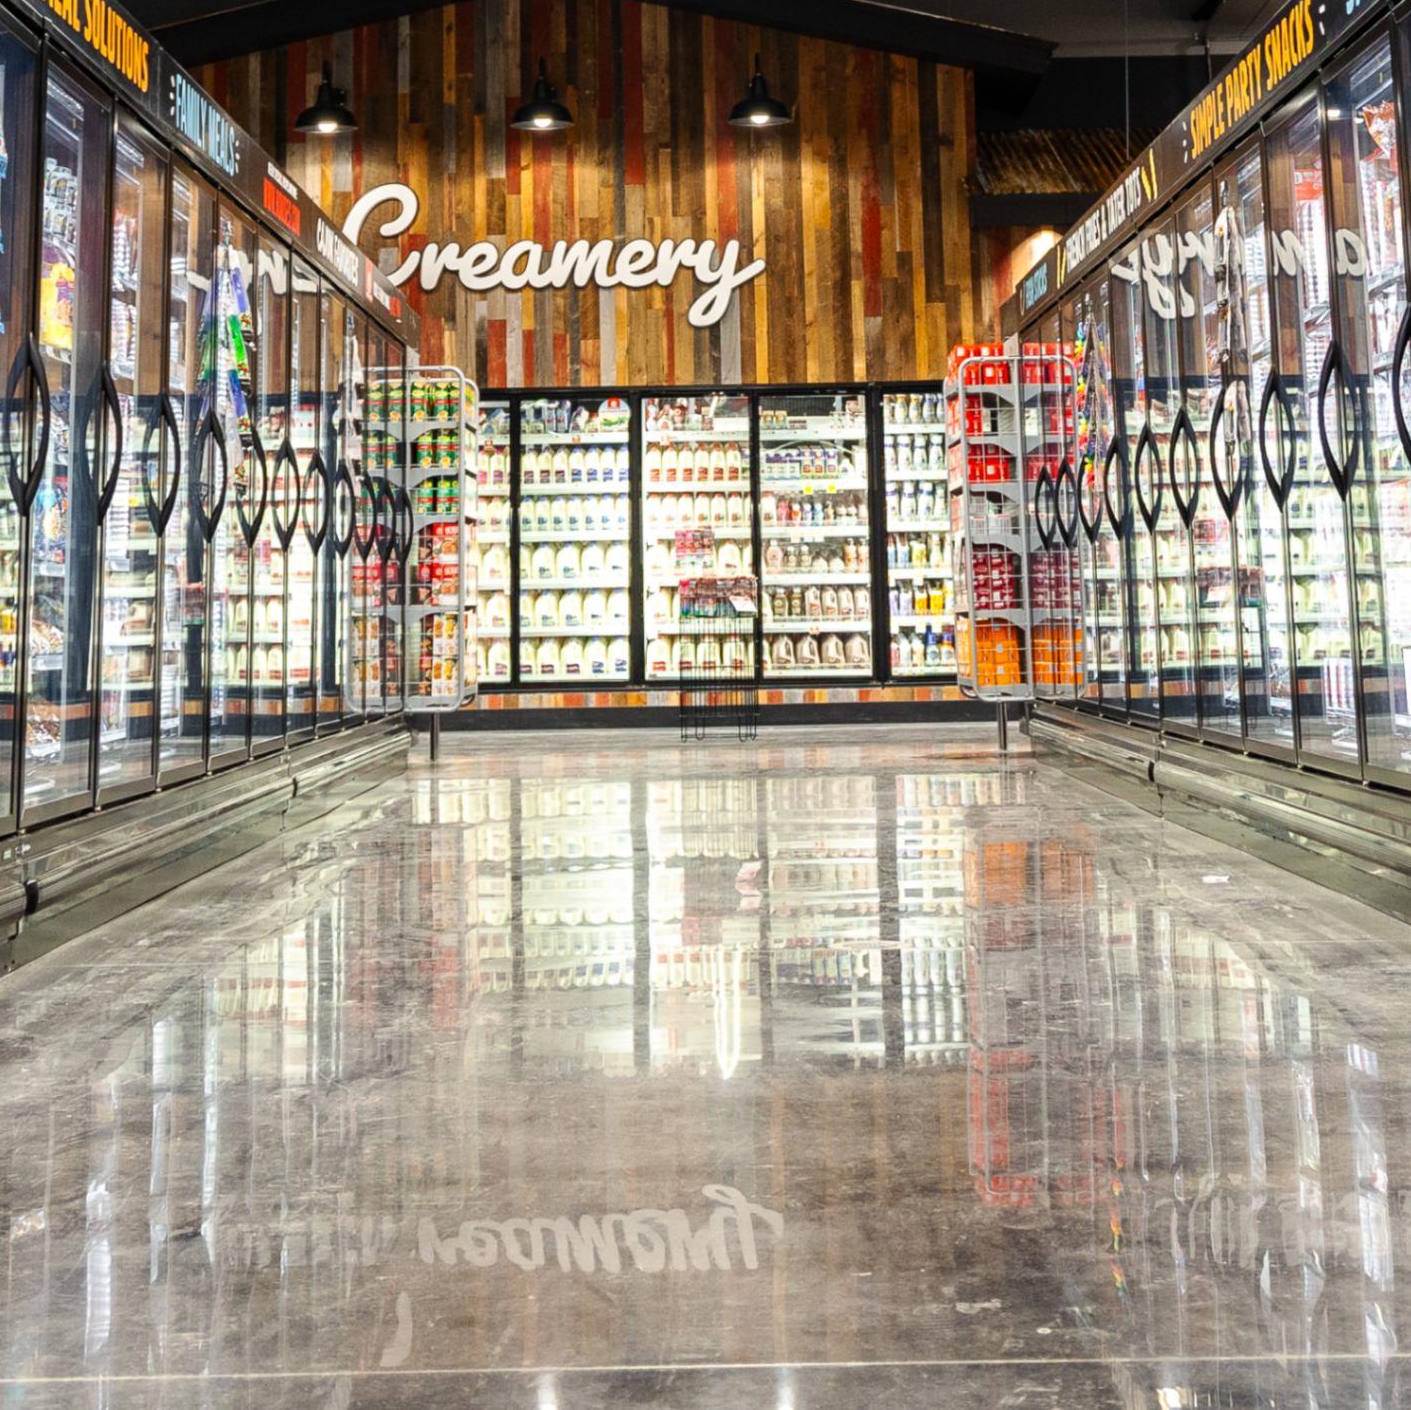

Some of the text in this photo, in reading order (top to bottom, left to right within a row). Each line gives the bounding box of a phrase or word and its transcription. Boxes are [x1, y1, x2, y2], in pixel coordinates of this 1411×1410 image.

[174, 73, 236, 178] FAMILY MEALS
[1189, 88, 1226, 161] SIMPLE
[1225, 51, 1263, 123] PARTY
[343, 182, 766, 328] Creamery
